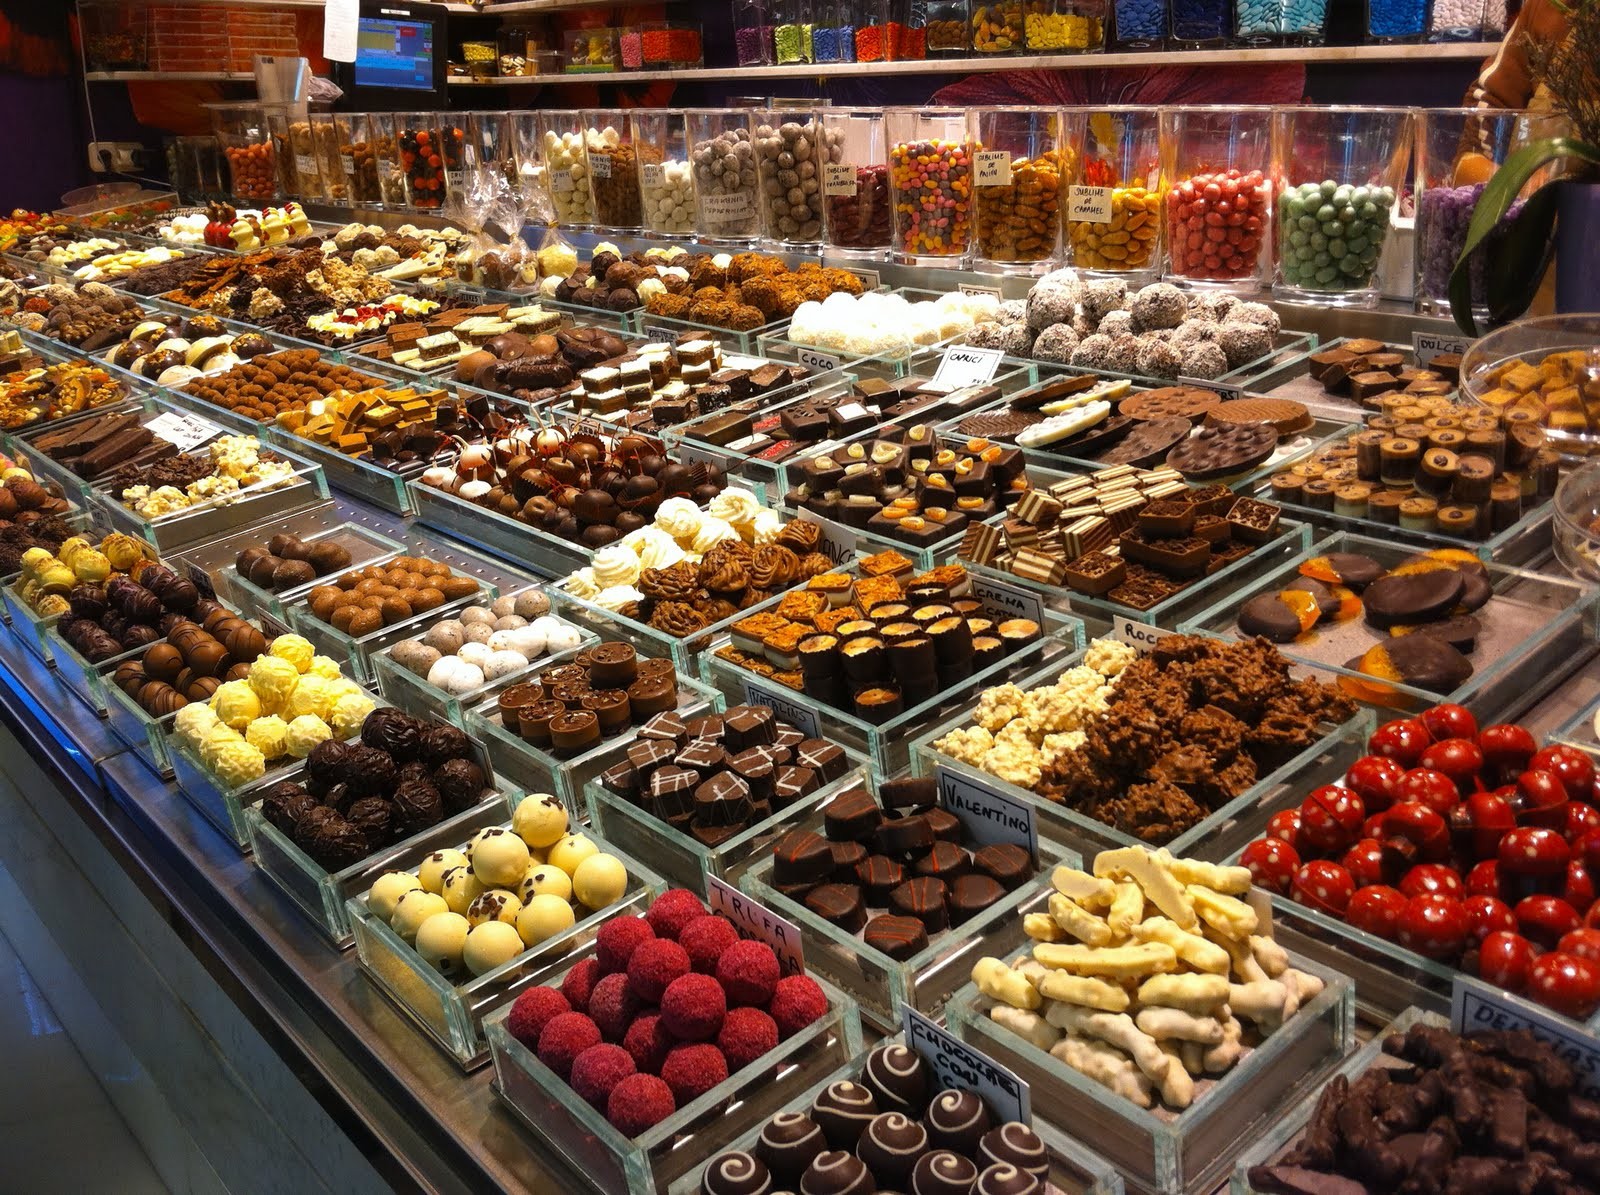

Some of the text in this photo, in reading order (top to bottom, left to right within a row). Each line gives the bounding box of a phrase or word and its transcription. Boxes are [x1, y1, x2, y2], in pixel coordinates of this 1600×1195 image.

[1074, 187, 1104, 197] SUBLIME
[801, 353, 834, 371] COCO
[976, 587, 1025, 611] CREMA
[946, 783, 1030, 834] VALENTINO
